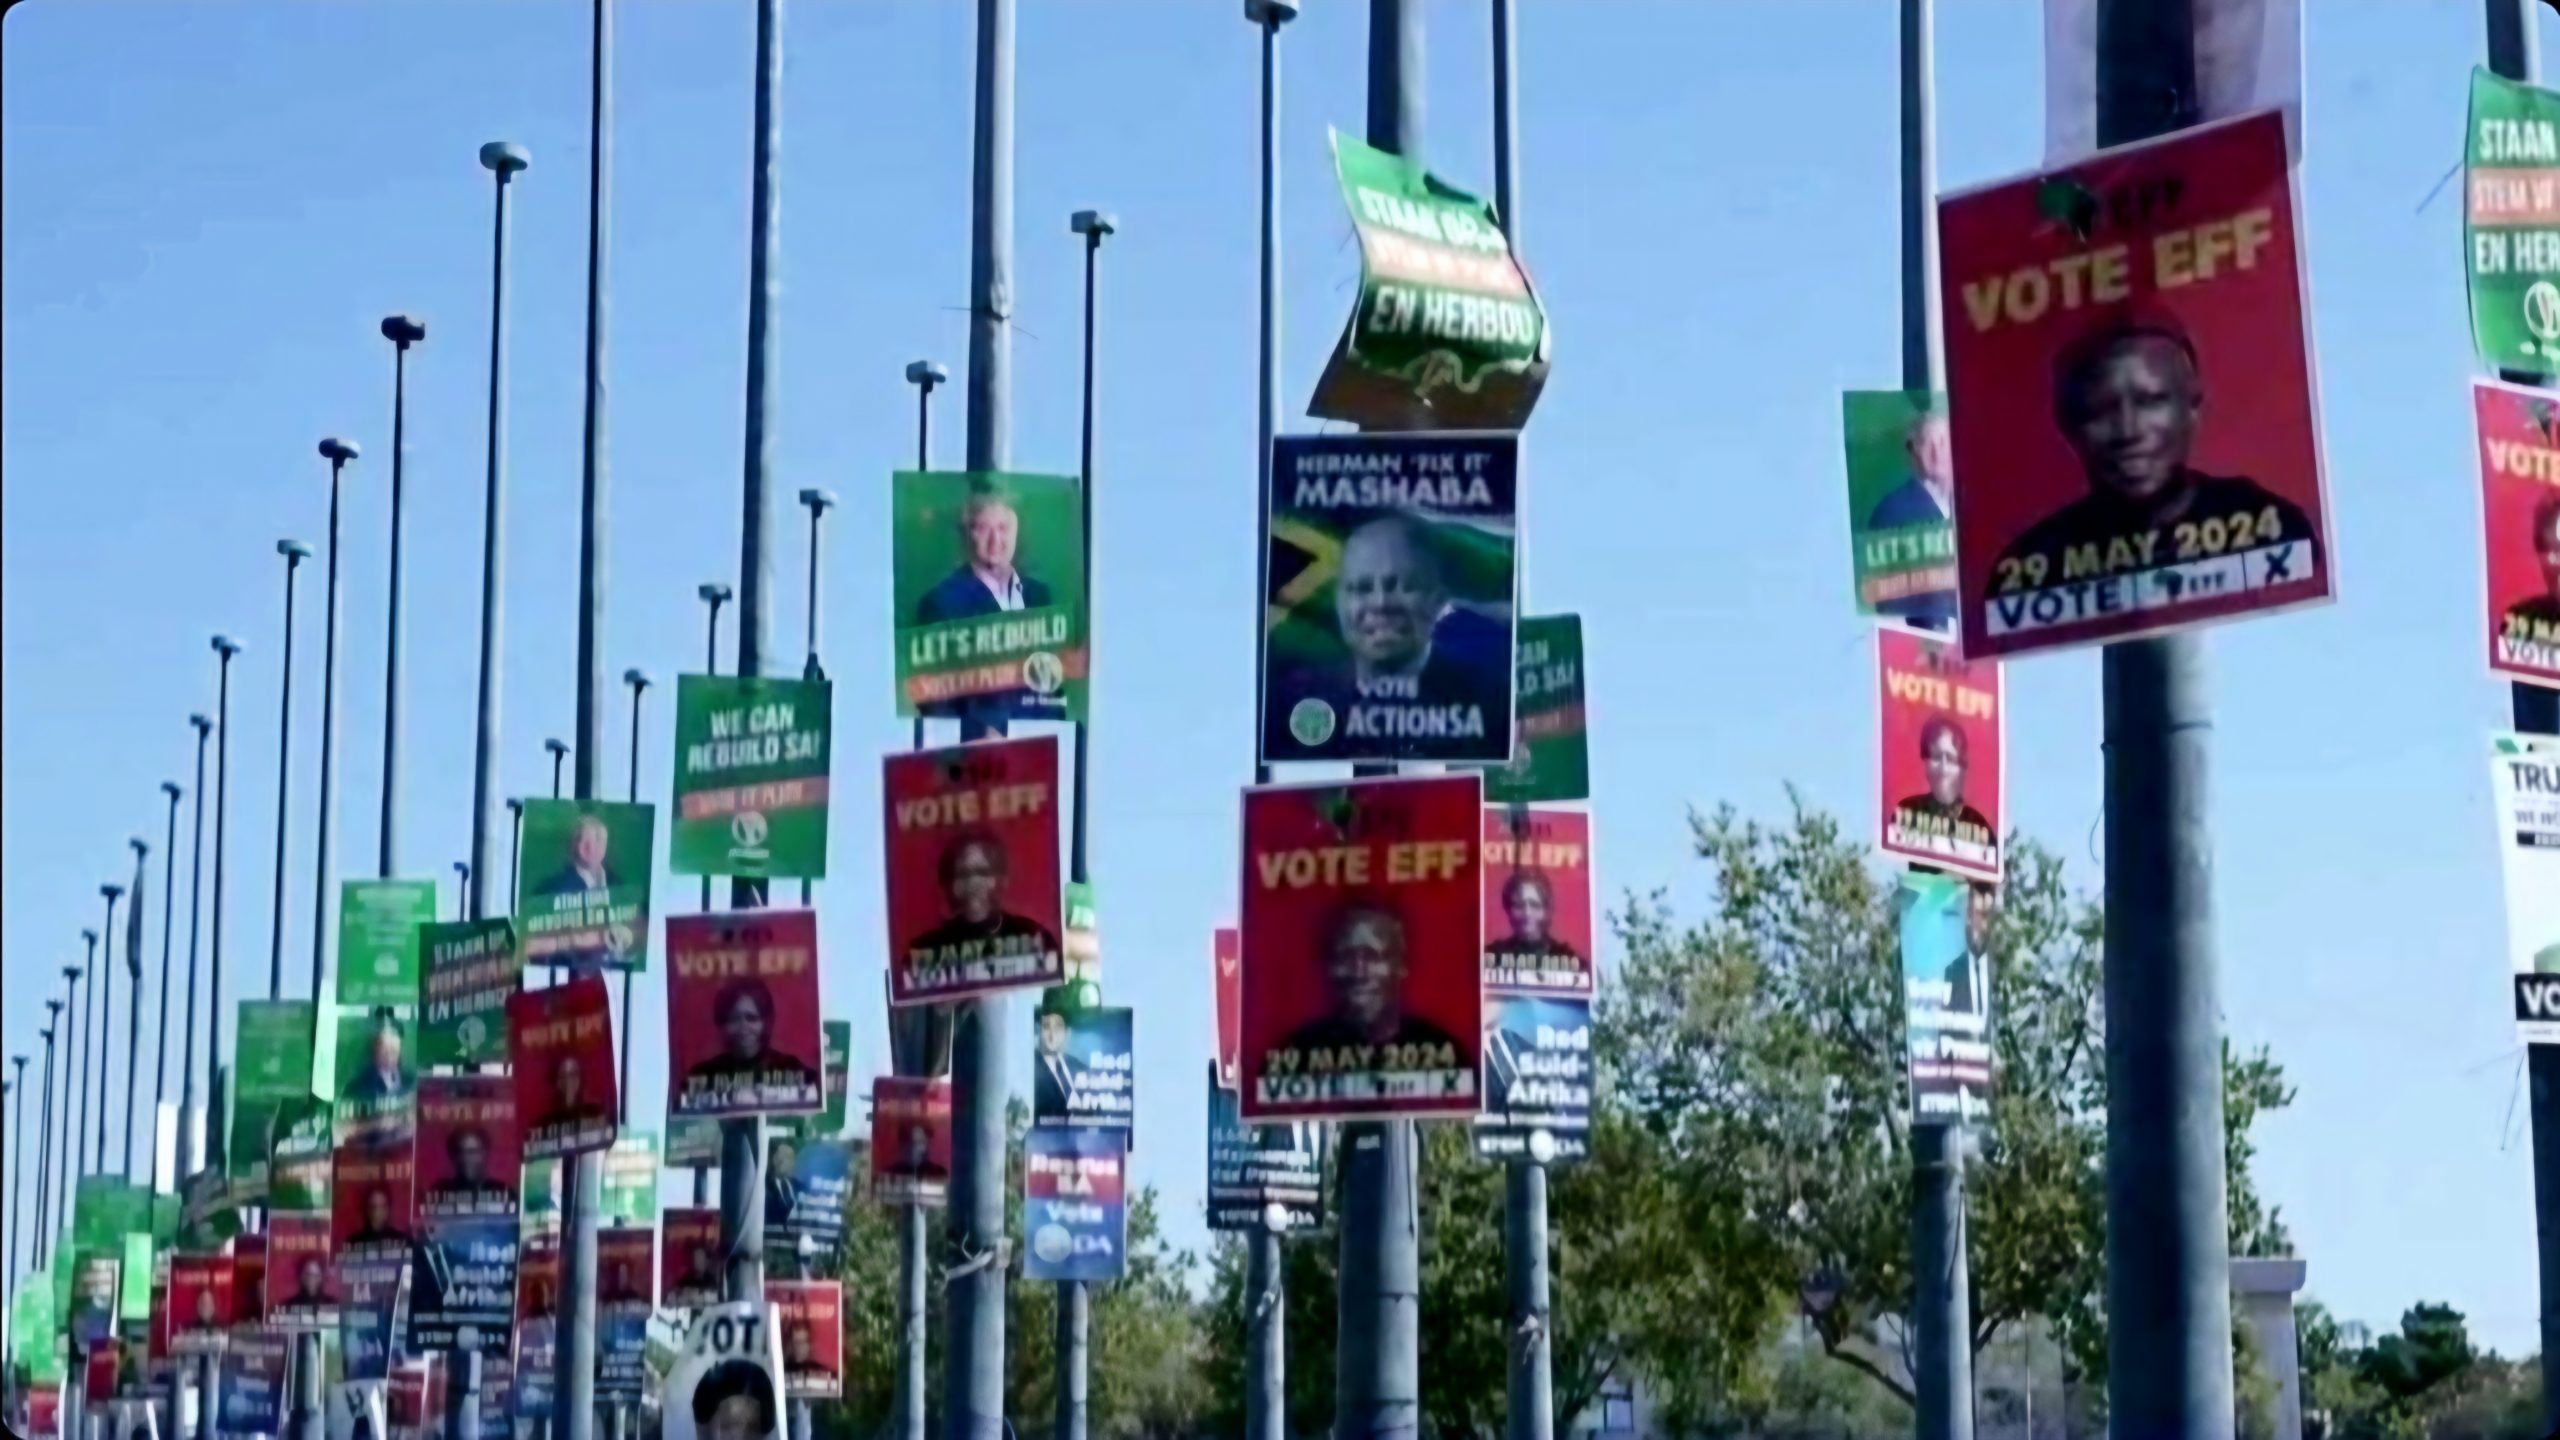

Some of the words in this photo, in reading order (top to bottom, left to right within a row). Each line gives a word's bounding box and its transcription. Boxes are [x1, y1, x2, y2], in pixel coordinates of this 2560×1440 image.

[1962, 243, 2131, 332] VOTE
[2153, 208, 2274, 290] EFF
[1369, 285, 1415, 333] EN
[1297, 454, 1401, 474] HERMAN
[1295, 477, 1493, 507] MASHABA
[1998, 552, 2049, 591] 29
[2063, 529, 2160, 580] MAY
[2173, 505, 2282, 556] 2024
[1998, 577, 2122, 630] VOTE
[911, 628, 971, 667] LET'S
[976, 613, 1068, 653] REBUILD
[1357, 676, 1420, 698] VOTE
[710, 708, 745, 738] WE
[750, 703, 795, 733] CAN
[1346, 704, 1485, 738] ACTIONSA
[687, 734, 780, 774] REBUILD
[896, 790, 981, 829] VOTE
[988, 782, 1047, 821] EFF
[1258, 845, 1371, 889] VOTE
[1387, 841, 1468, 883] EFF
[1484, 841, 1533, 866] OTE
[676, 950, 748, 977] VOTE
[758, 947, 808, 975] EFF
[1308, 1045, 1375, 1071] MAY
[1384, 1041, 1457, 1069] 2024
